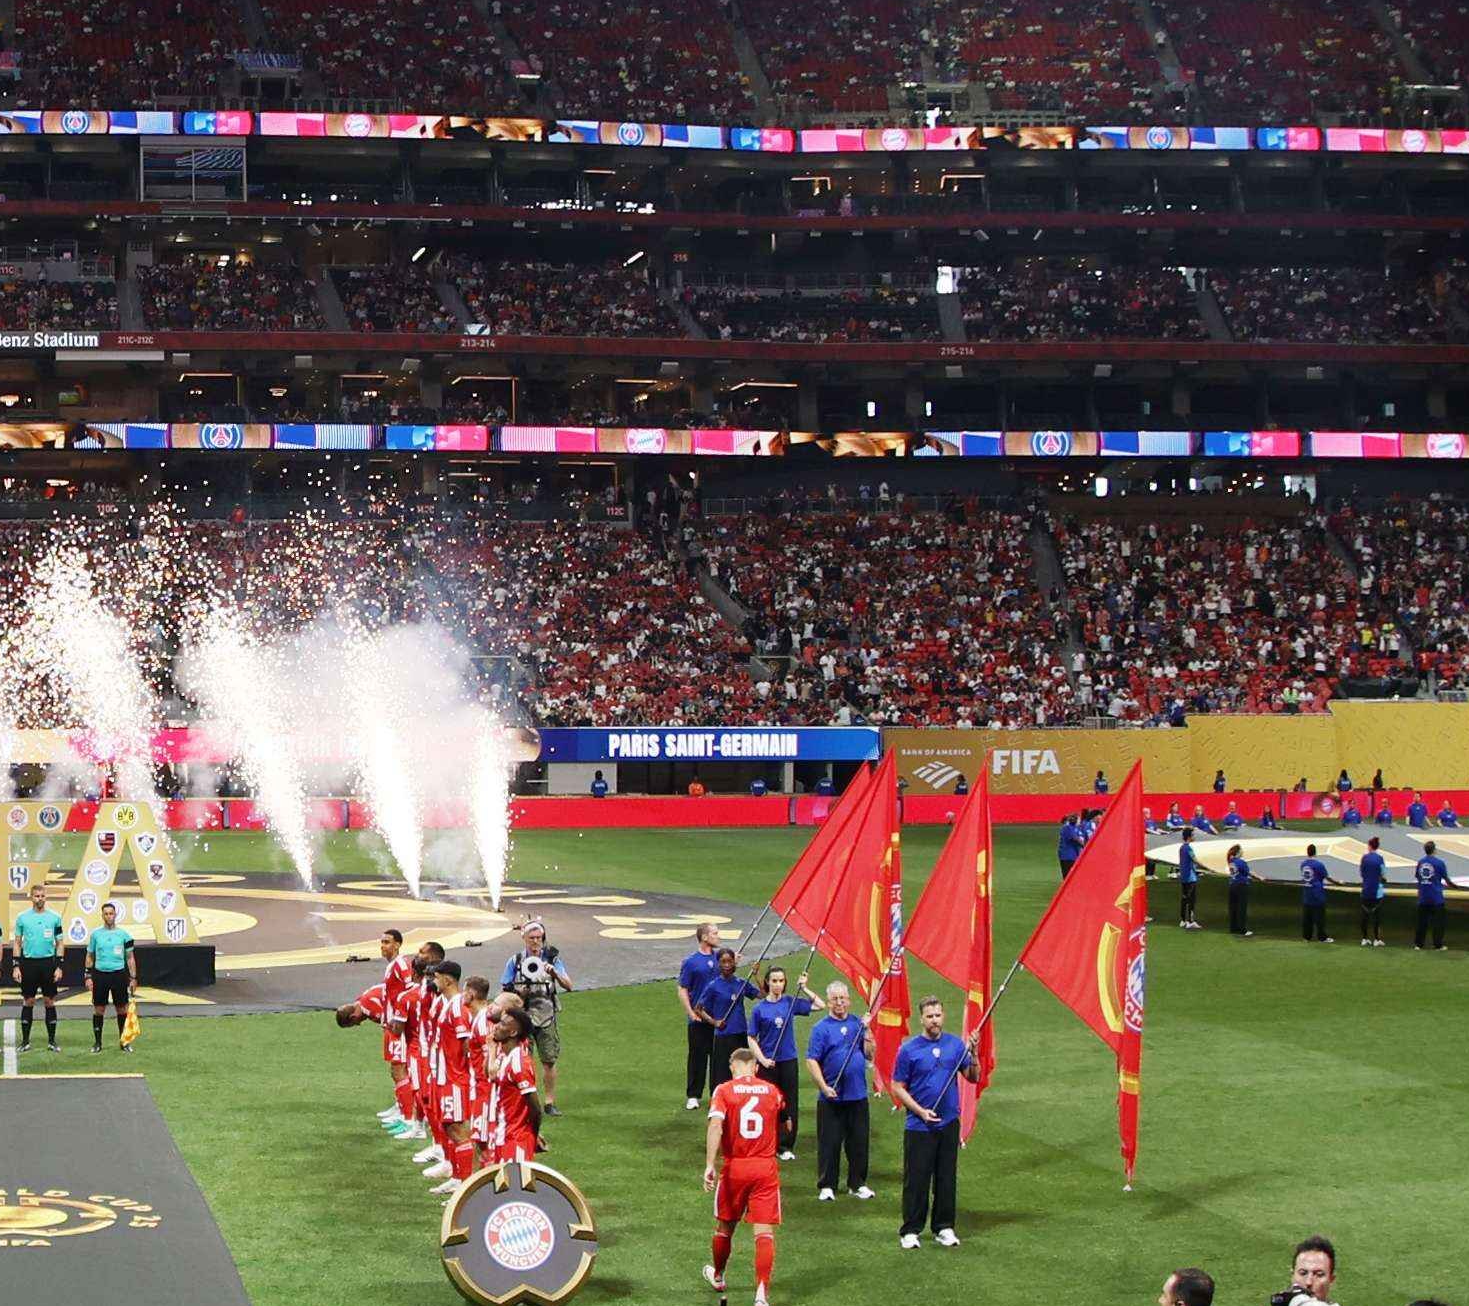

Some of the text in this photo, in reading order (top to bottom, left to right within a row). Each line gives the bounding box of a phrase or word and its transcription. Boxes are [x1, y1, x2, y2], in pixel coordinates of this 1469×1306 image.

[33, 331, 99, 348] Stadium
[461, 339, 495, 348] 213-214
[606, 507, 624, 516] 112C
[608, 733, 798, 757] PARIS SAINT-GERMAIN
[992, 749, 1060, 775] FIFA
[739, 1095, 763, 1139] 6
[89, 1194, 154, 1218] CUP
[490, 1204, 548, 1234] FC BAYERN
